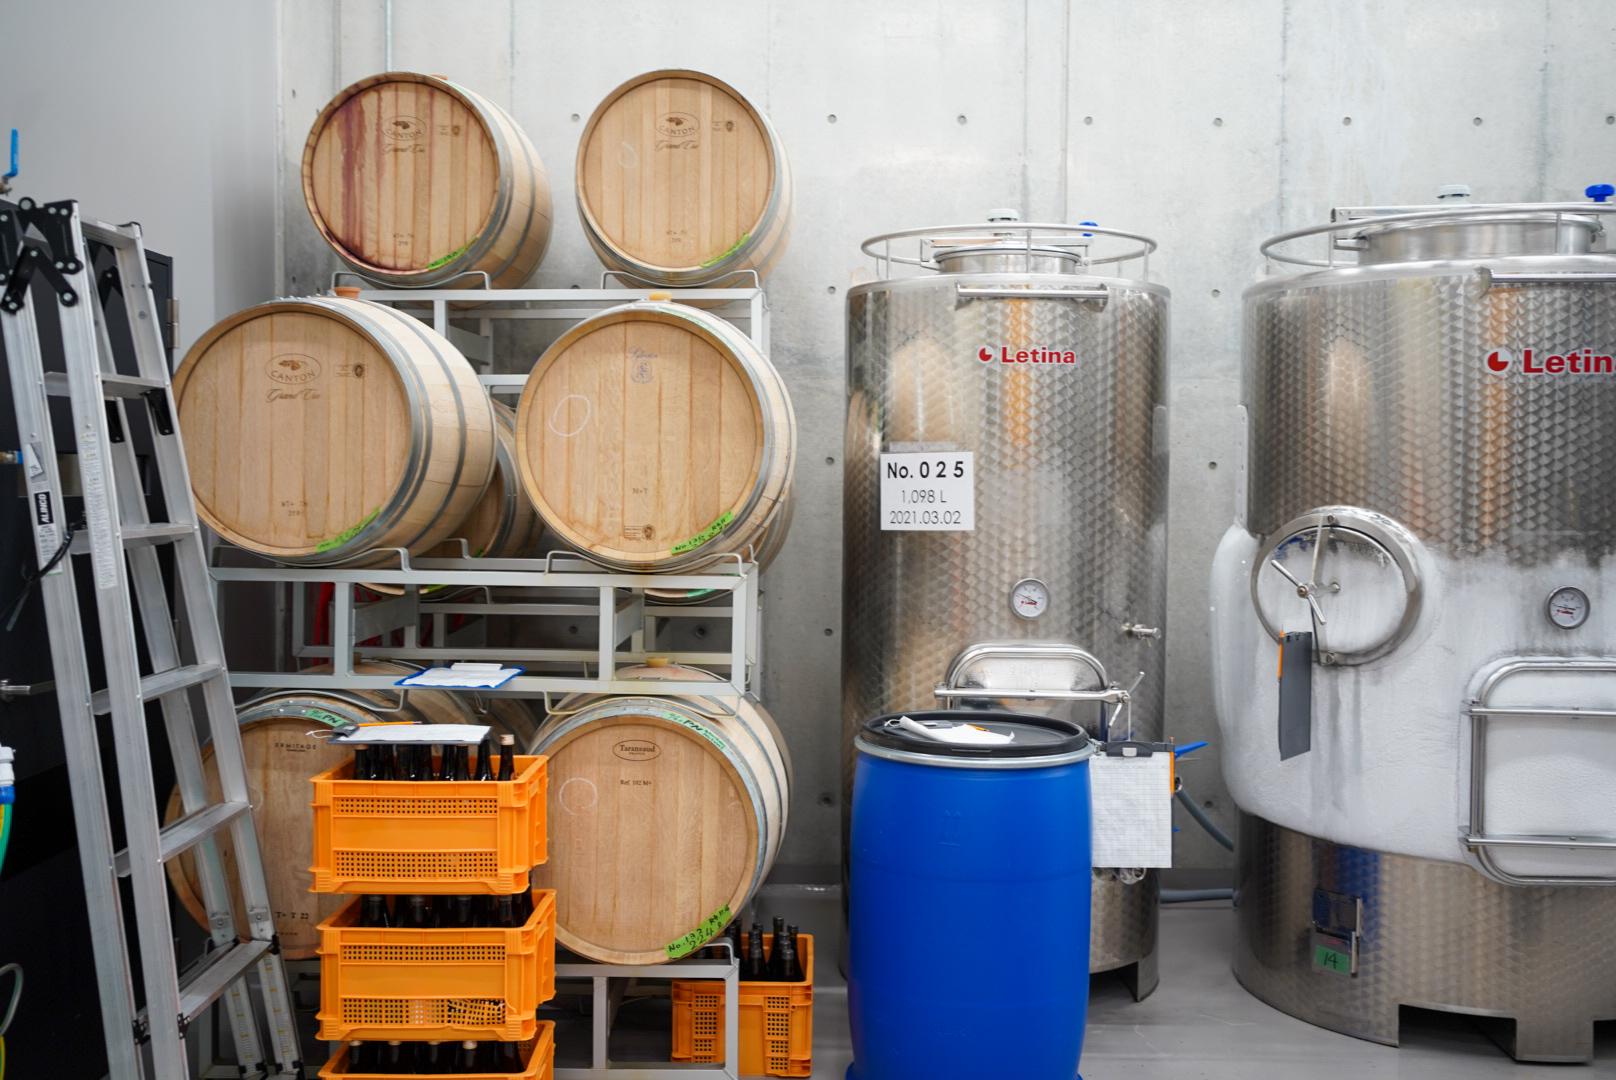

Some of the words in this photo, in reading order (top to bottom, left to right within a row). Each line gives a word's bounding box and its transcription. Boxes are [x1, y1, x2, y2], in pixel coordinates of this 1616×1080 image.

[1002, 347, 1075, 363] Letina
[1523, 348, 1616, 374] Letin
[271, 369, 316, 381] CANTON
[940, 489, 947, 503] L
[38, 493, 50, 524] ALINCO
[890, 510, 961, 525] 2021.03.02
[1324, 952, 1338, 968] 14
